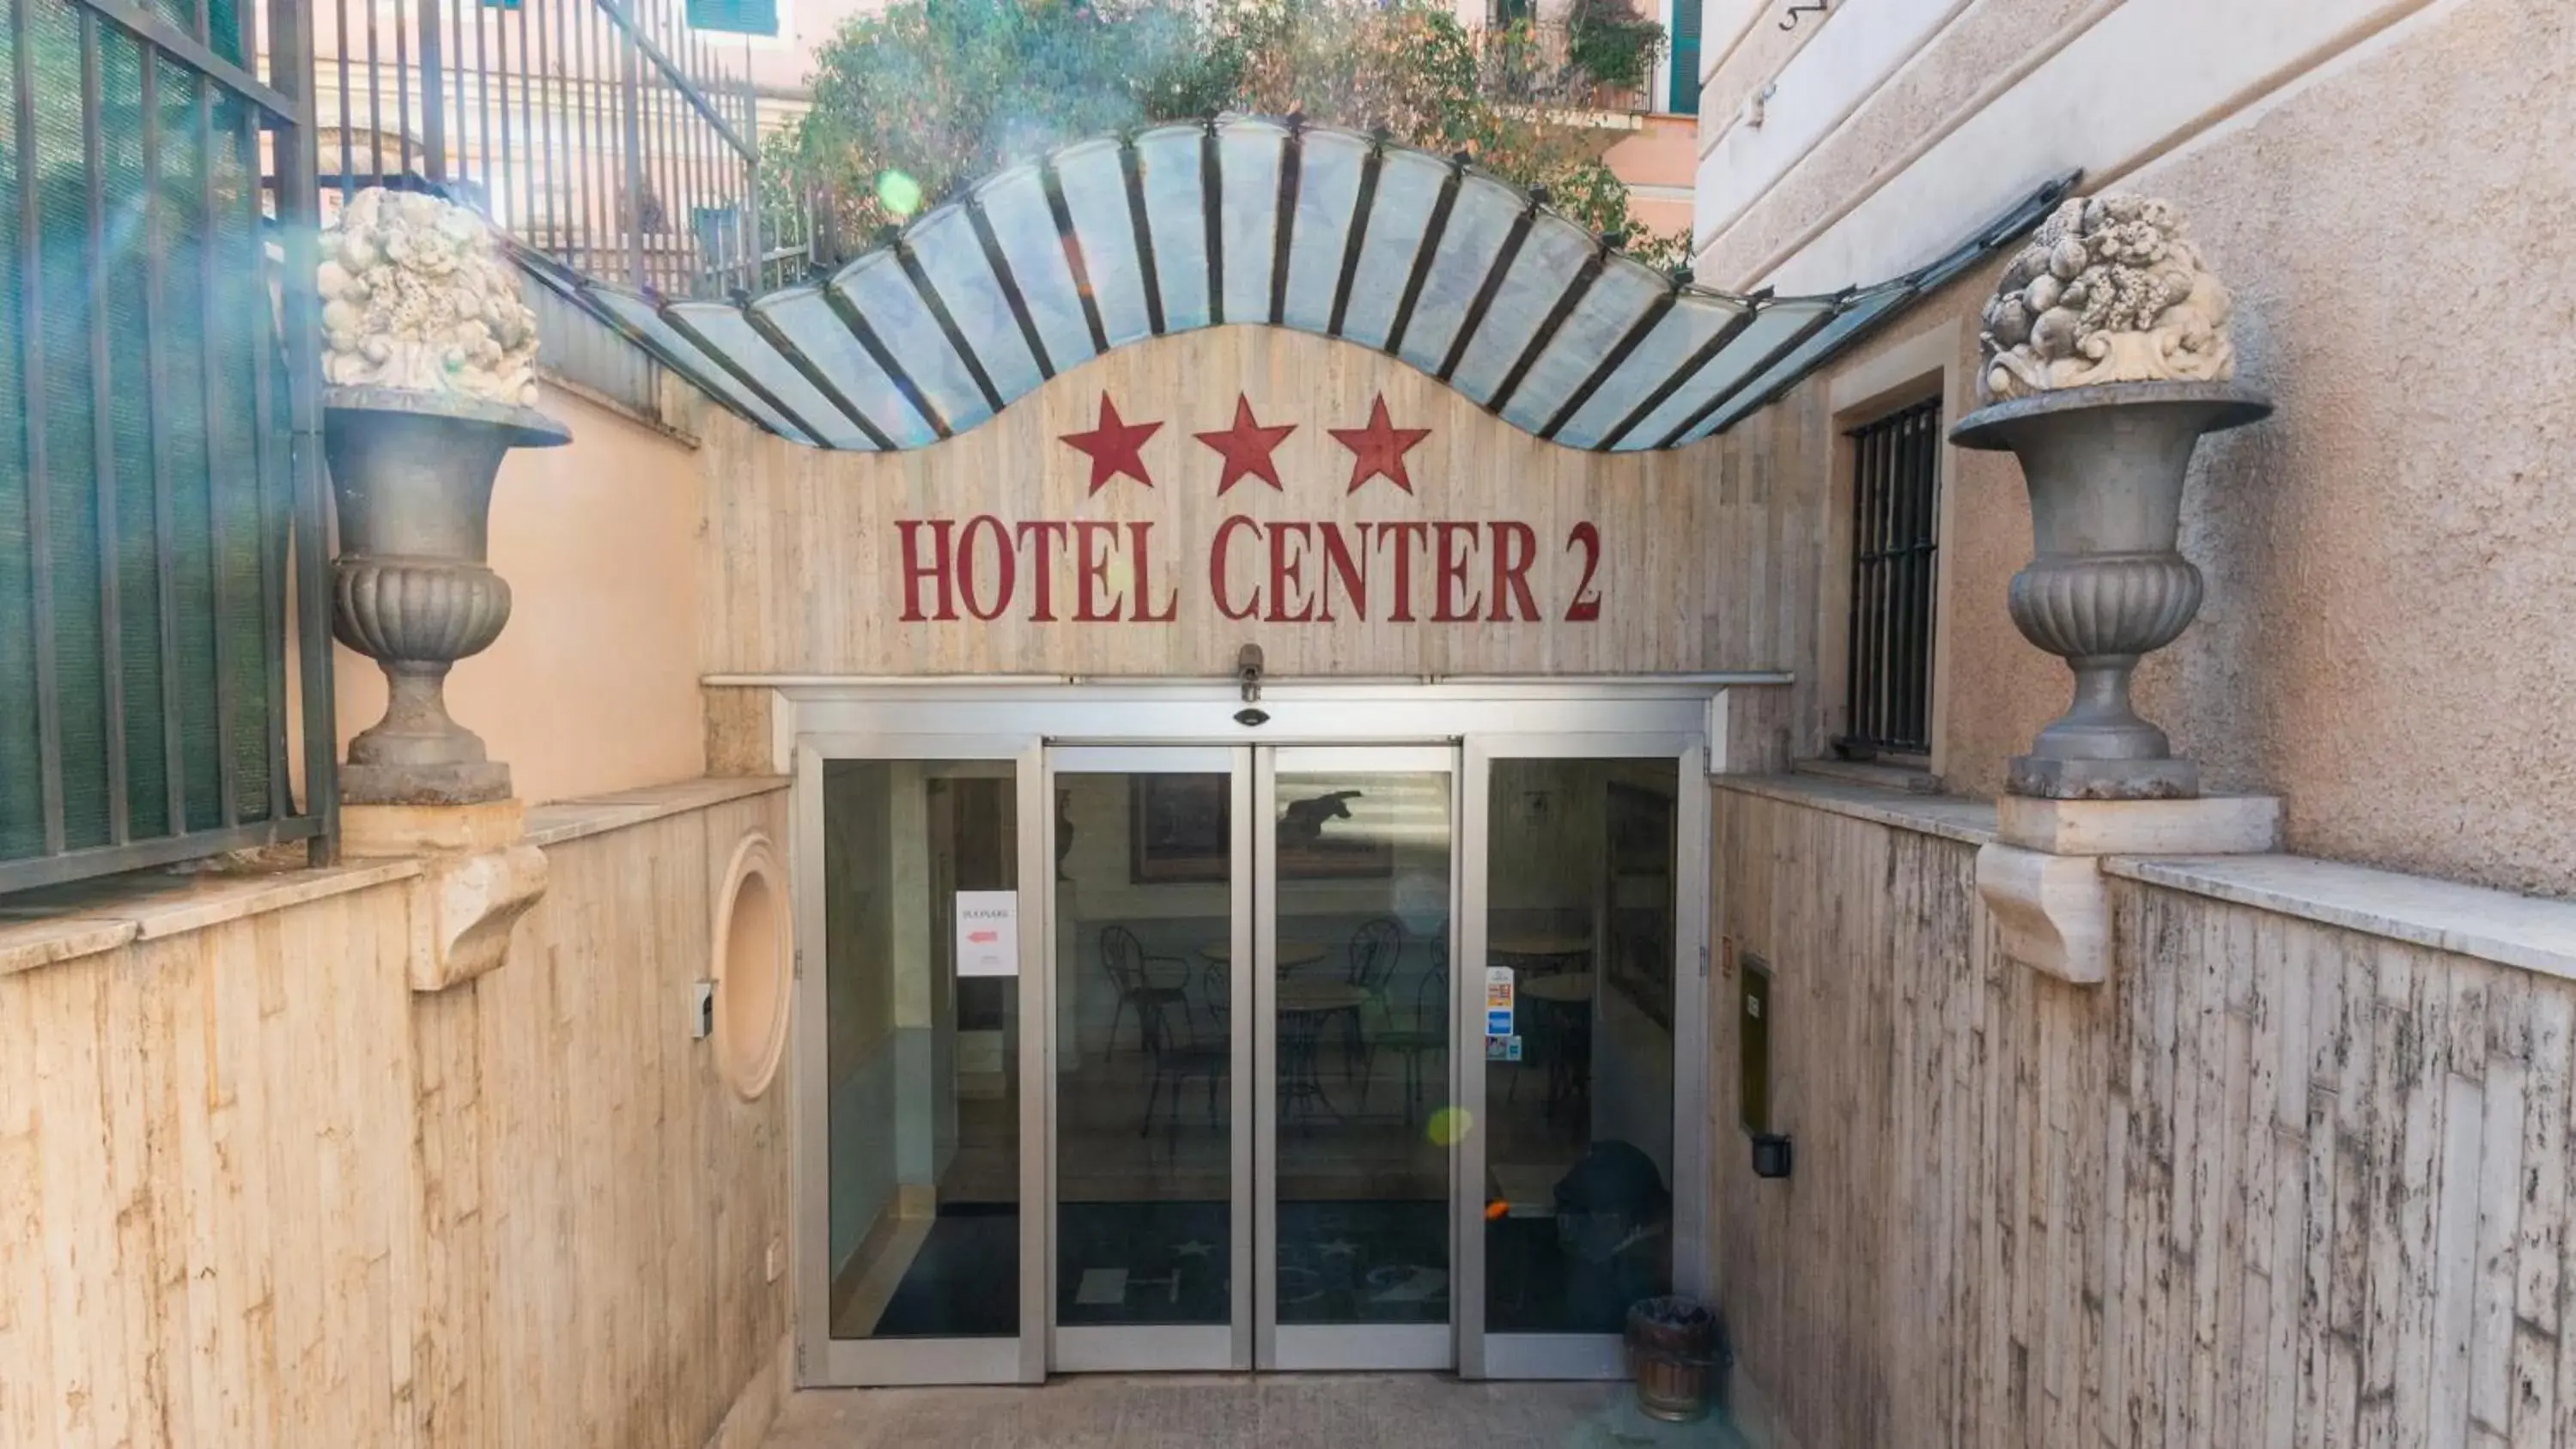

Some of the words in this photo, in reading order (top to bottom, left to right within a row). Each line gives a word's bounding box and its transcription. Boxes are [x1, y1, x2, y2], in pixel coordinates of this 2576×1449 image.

[895, 515, 1177, 623] HOTEL
[1210, 515, 1542, 623] CENTER
[1565, 521, 1601, 622] 2
